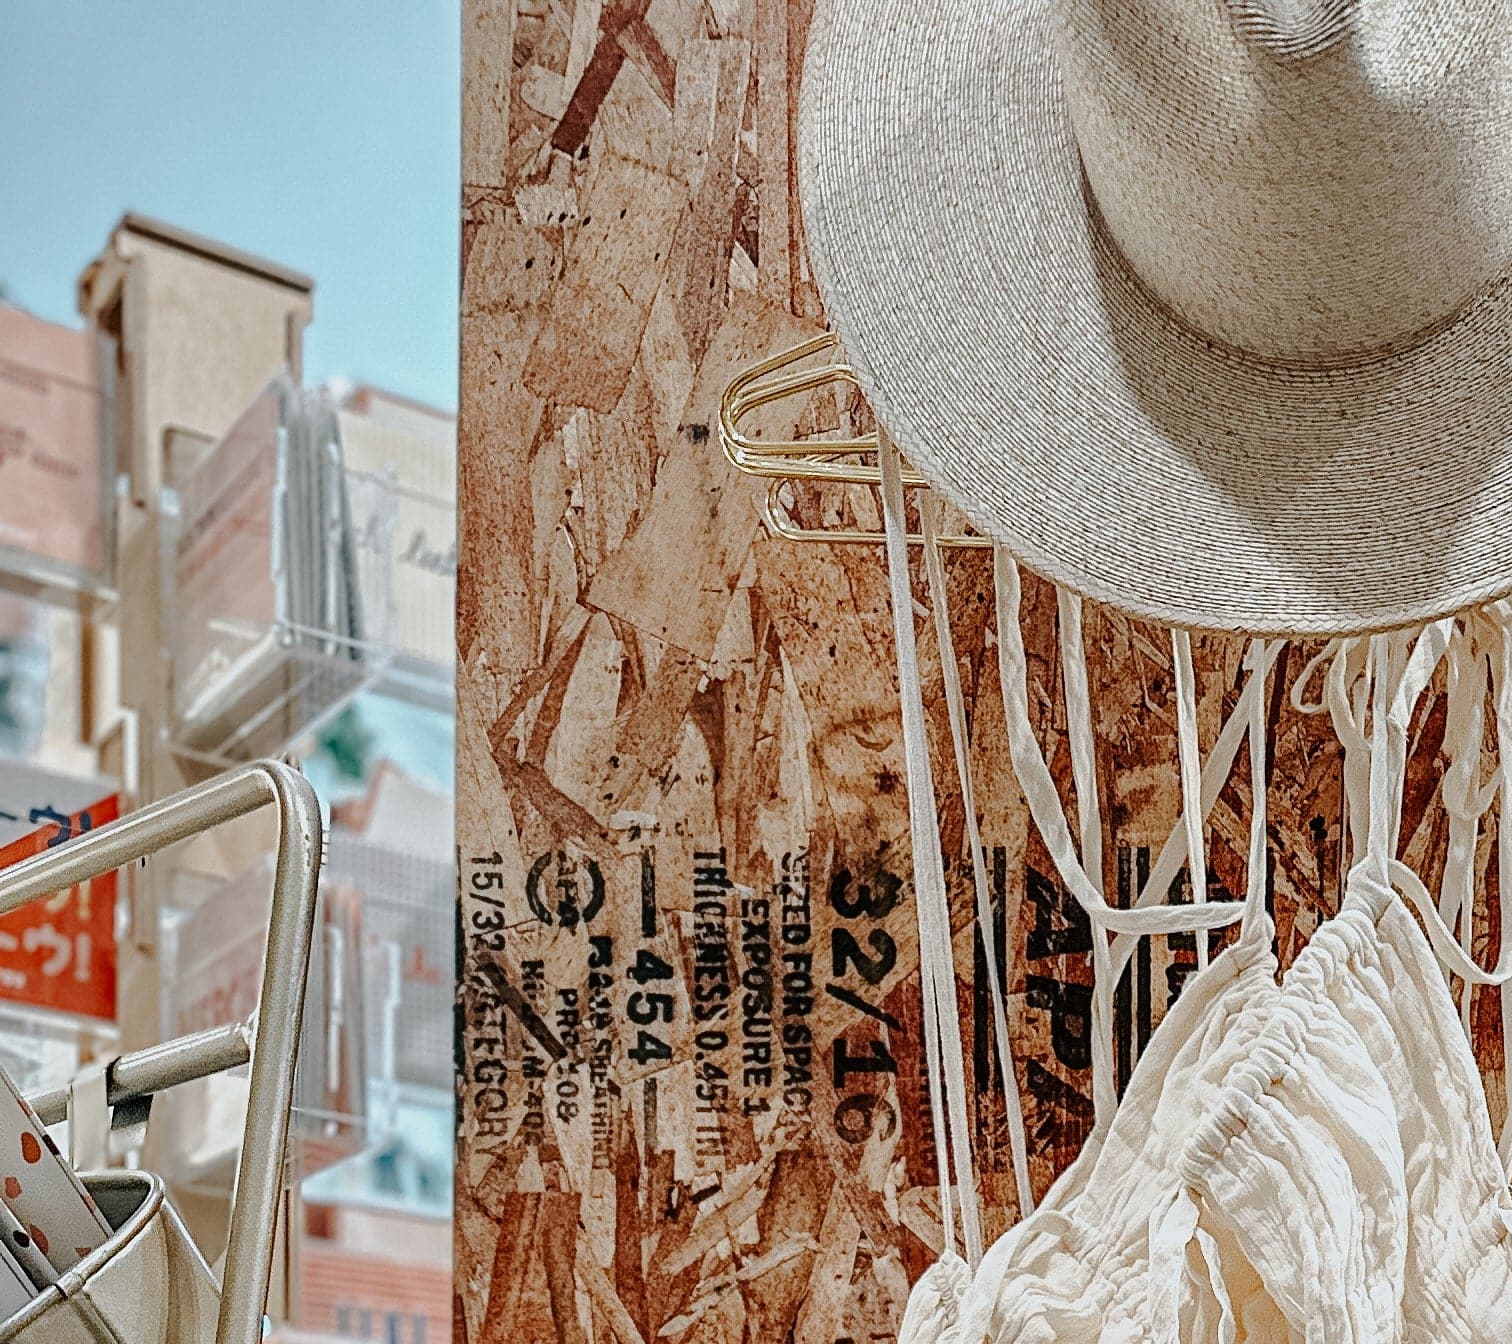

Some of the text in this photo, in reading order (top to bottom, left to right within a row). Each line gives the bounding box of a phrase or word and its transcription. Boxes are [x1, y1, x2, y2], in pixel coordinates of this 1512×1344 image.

[469, 851, 506, 952] 15/32
[692, 846, 729, 1020] THICKNESS
[626, 950, 675, 1065] 454
[741, 899, 773, 1118] EXPOSURE 1
[781, 952, 813, 1018] FOR
[826, 866, 906, 1144] 32/16
[694, 1031, 729, 1114] 0.451
